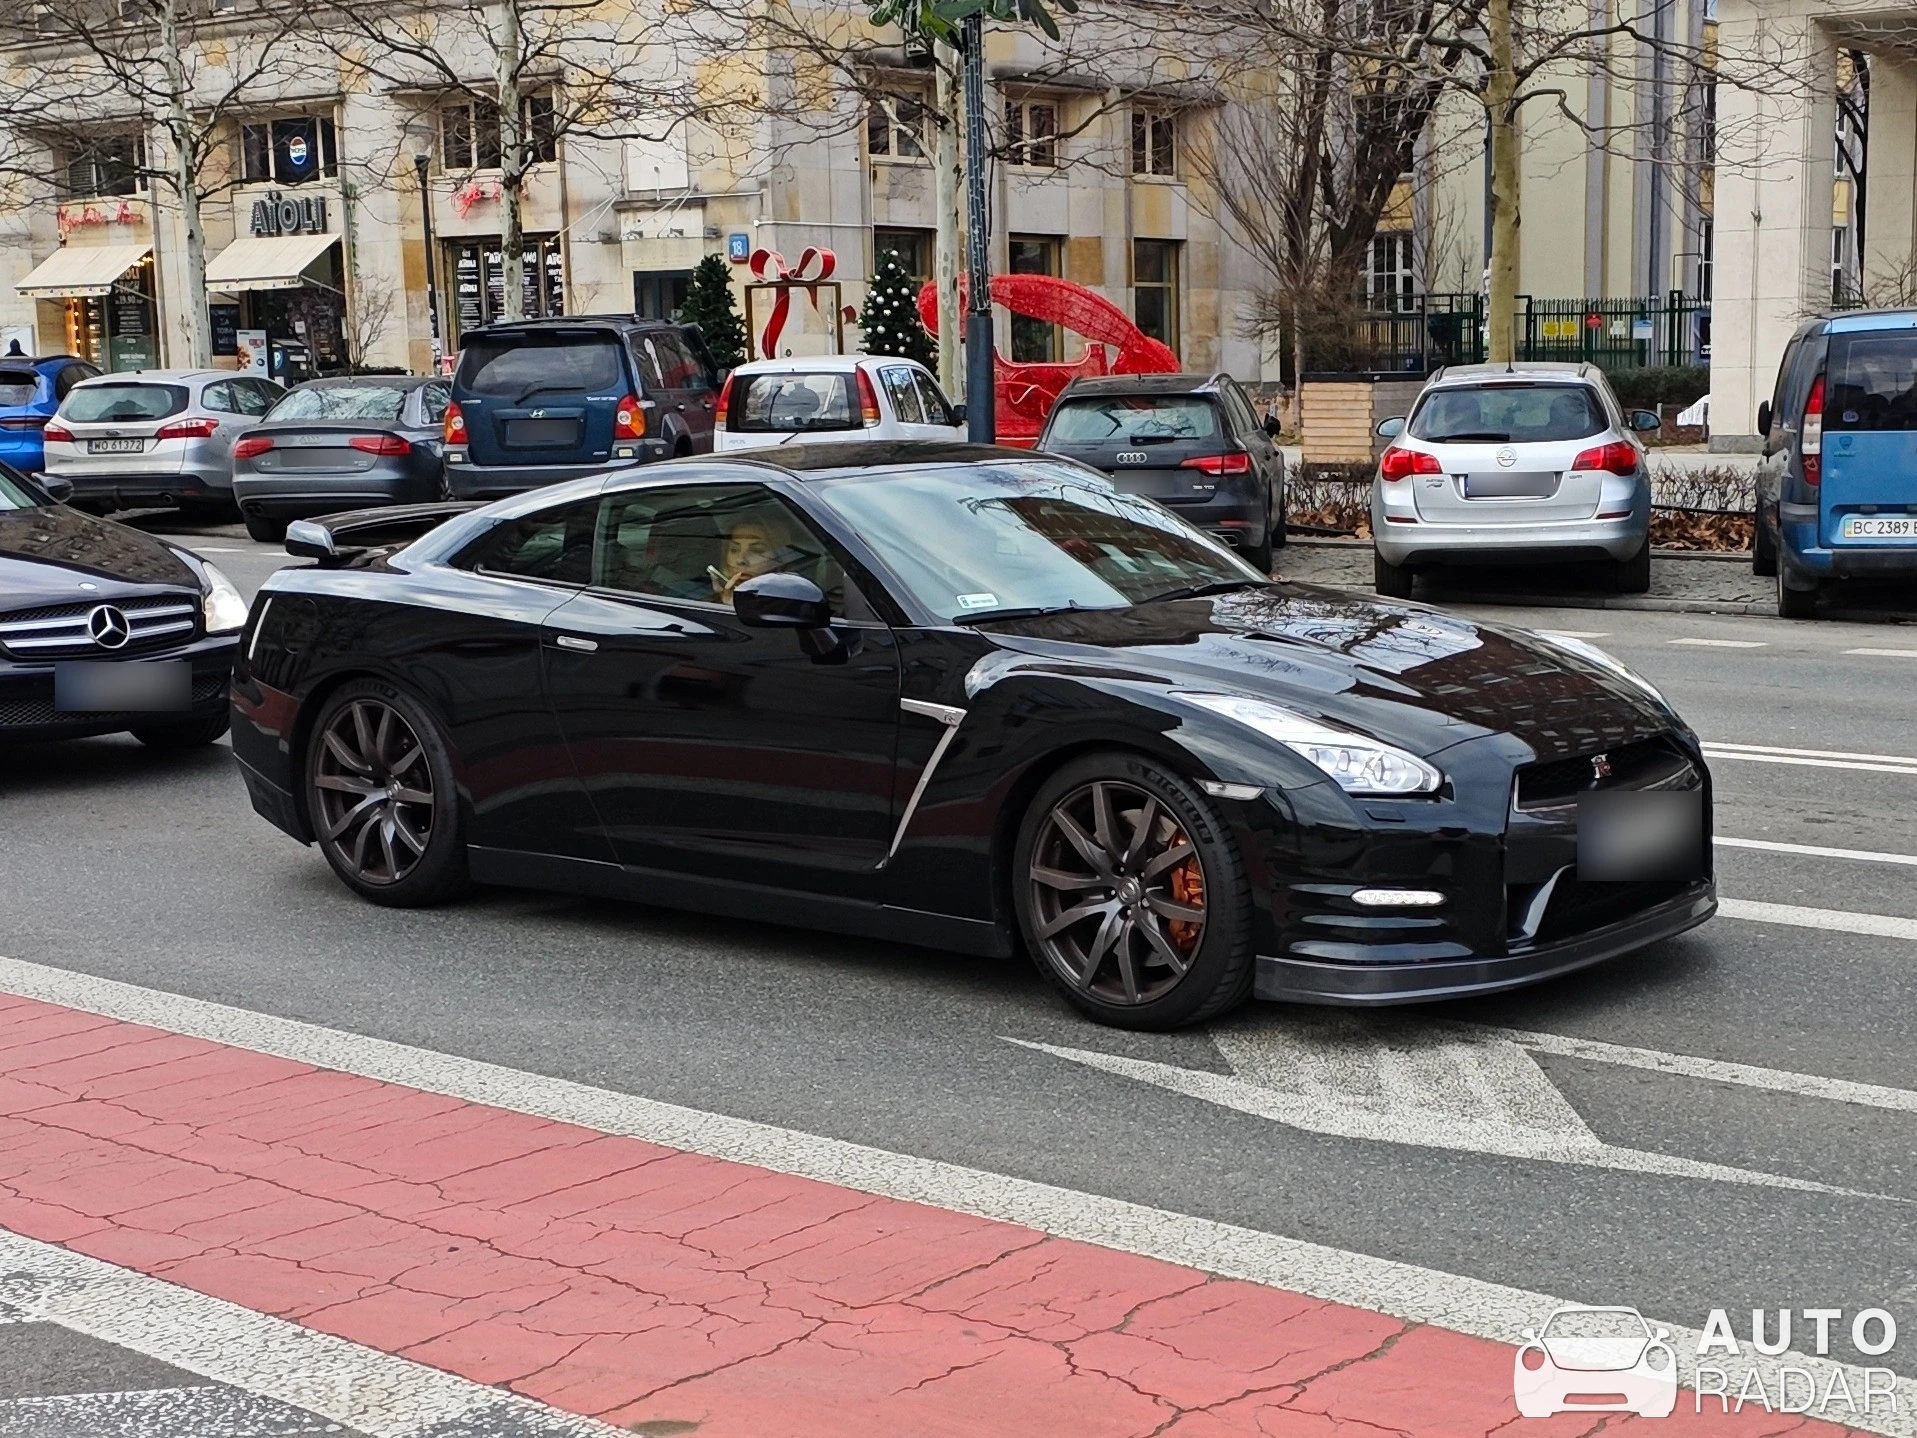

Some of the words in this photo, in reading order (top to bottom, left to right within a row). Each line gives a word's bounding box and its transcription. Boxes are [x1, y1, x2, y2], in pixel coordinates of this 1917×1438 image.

[249, 191, 327, 237] AÏOLI
[732, 240, 743, 256] 18
[94, 441, 109, 450] WO
[111, 440, 142, 450] 61372
[1853, 521, 1873, 534] BC
[1877, 521, 1909, 534] 2389
[1147, 768, 1213, 843] MICHELIN
